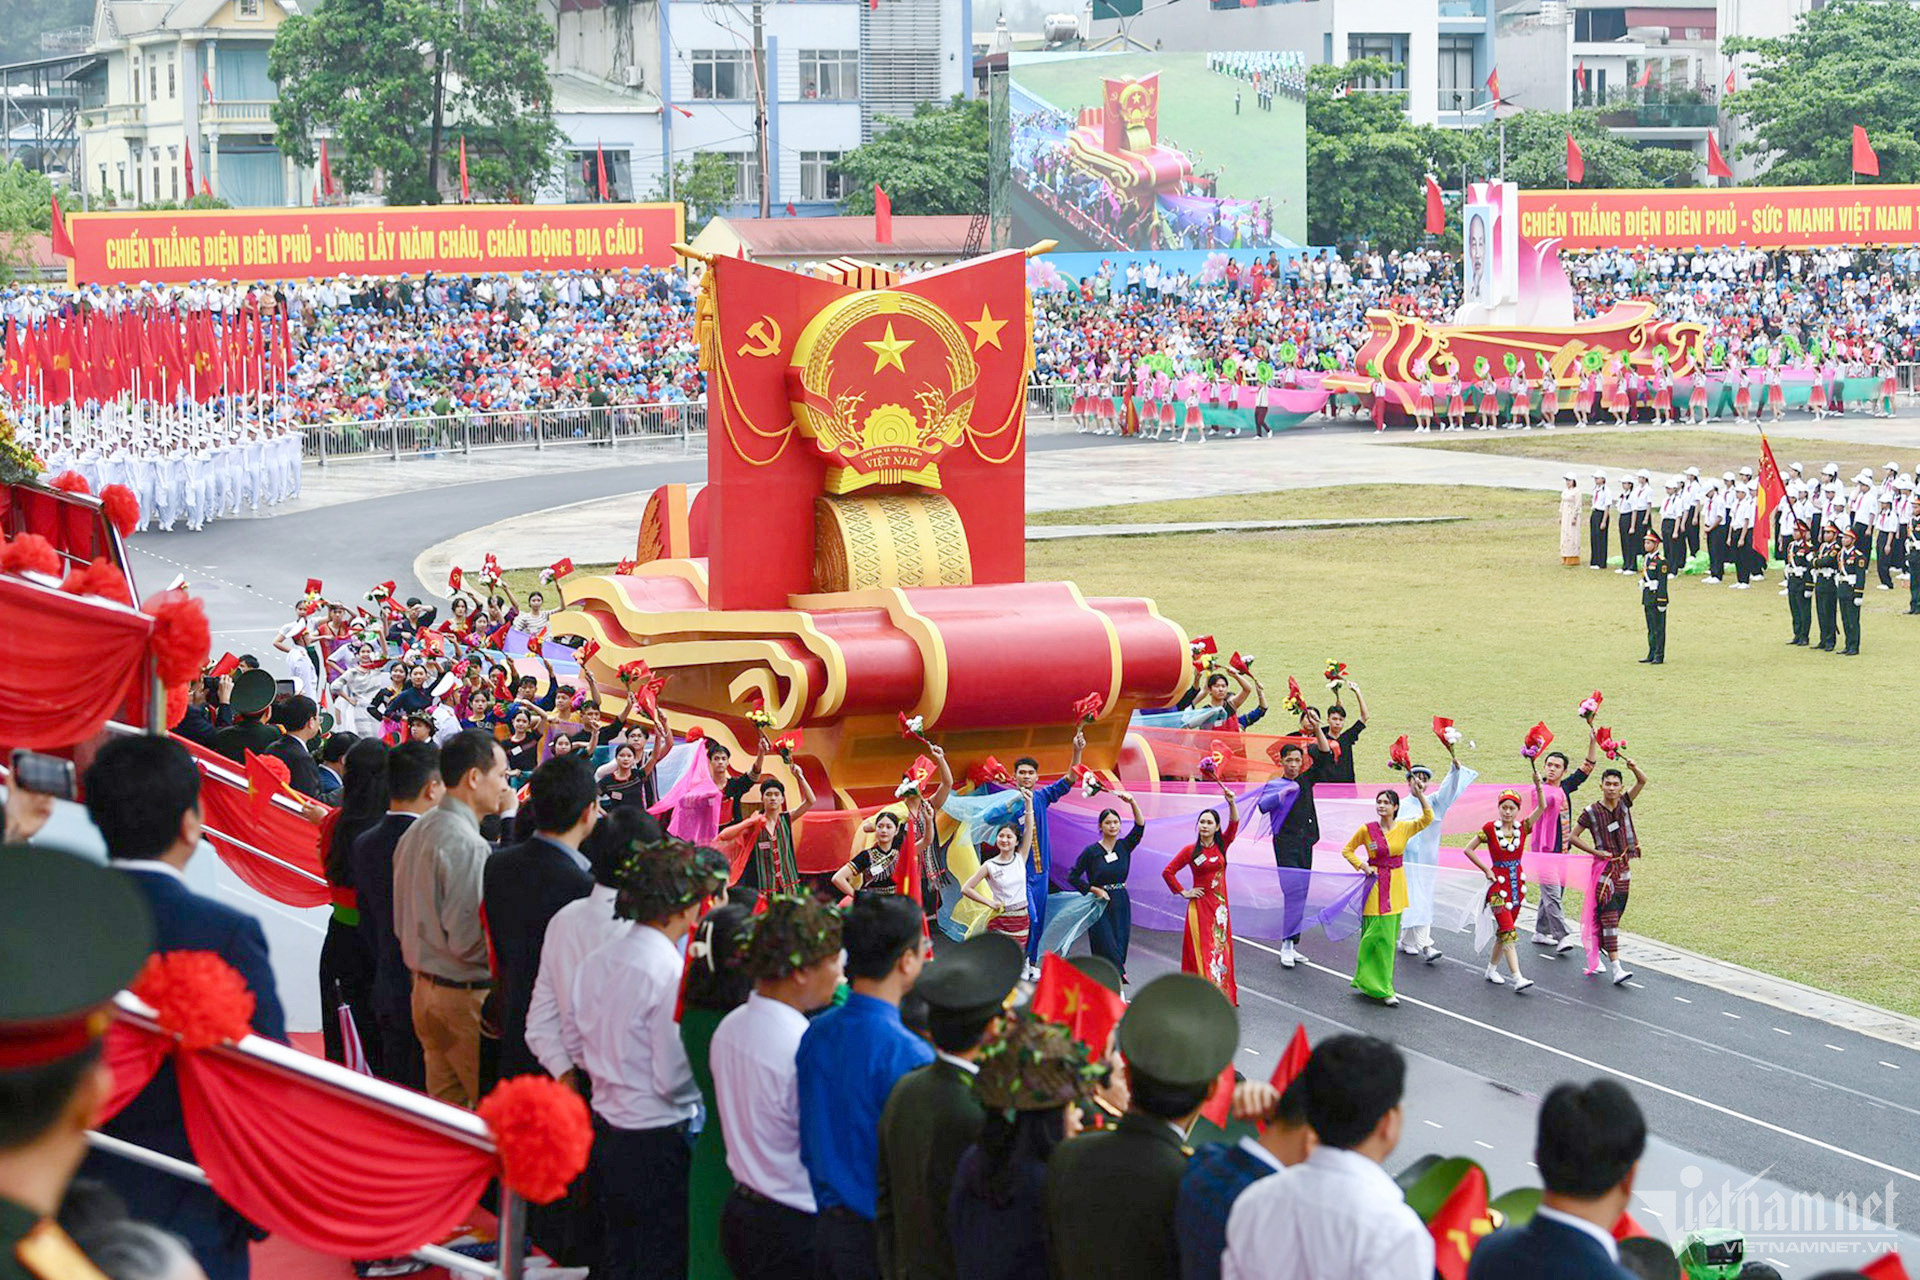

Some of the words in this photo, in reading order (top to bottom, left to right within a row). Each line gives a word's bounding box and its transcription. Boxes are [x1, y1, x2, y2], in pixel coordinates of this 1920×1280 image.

[1521, 203, 1567, 237] CHIẾN
[1570, 201, 1621, 236] THẮNG
[1624, 205, 1661, 241] ĐIỆN
[1665, 205, 1701, 236] BIÊN
[1705, 201, 1737, 235] PHỦ
[1751, 203, 1783, 234] SỨC
[1787, 207, 1834, 239] MẠNH
[1838, 200, 1872, 238] VIỆT
[1875, 206, 1912, 232] NAM
[105, 228, 150, 270] CHIẾN
[152, 225, 201, 268] THẮNG
[203, 229, 240, 273] ĐIỆN
[242, 228, 278, 265] BIÊN
[281, 224, 312, 264] PHỦ
[325, 226, 365, 262] LỪNG
[368, 220, 396, 261] LẪY
[399, 225, 435, 260] NĂM
[439, 223, 484, 262] CHÂU,
[486, 218, 528, 258] CHẤN
[530, 223, 572, 263] ĐỘNG
[575, 227, 602, 262] ĐỊA
[865, 455, 890, 468] VIỆT
[893, 456, 918, 467] NAM
